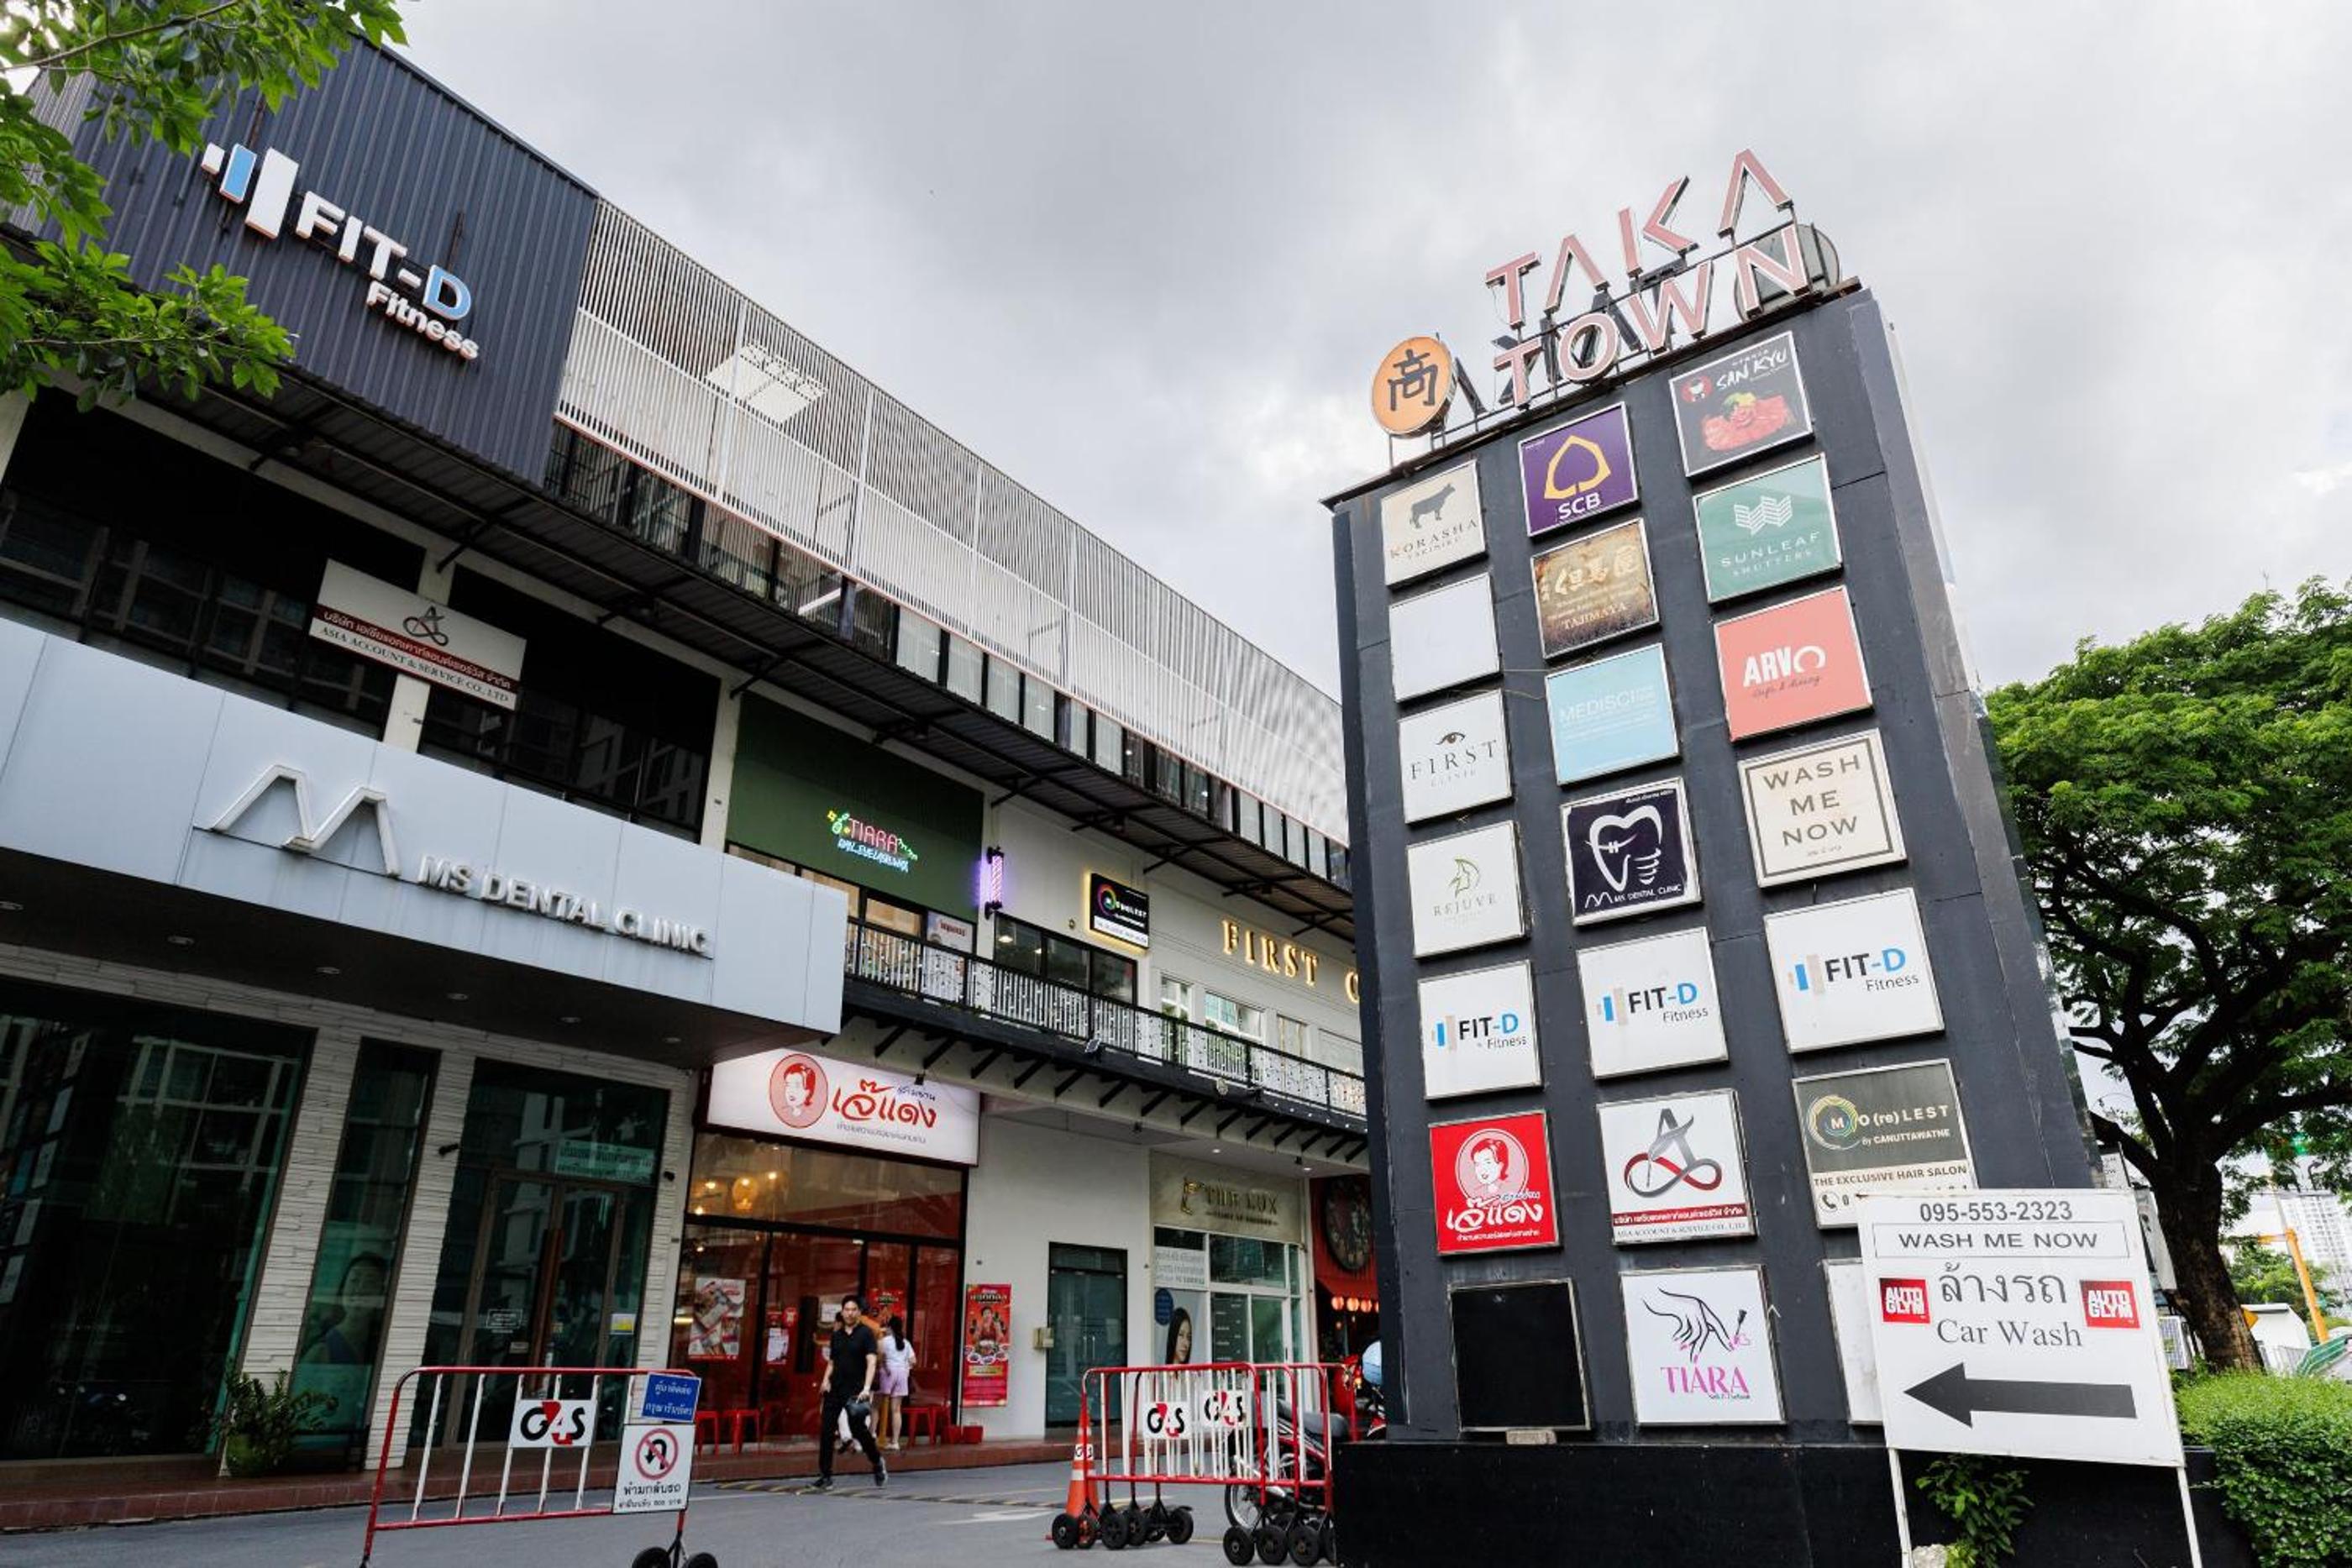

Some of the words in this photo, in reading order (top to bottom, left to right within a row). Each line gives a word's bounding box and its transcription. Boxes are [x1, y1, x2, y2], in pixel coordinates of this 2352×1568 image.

[296, 191, 472, 321] FIT-D
[1486, 149, 1794, 330] TAKA
[366, 281, 480, 360] Fitness
[1494, 223, 1811, 409] TOWN
[1716, 364, 1749, 390] SAN
[1753, 348, 1788, 374] KYU
[1558, 492, 1602, 520] SCB
[1721, 530, 1820, 568] SUNLEAF
[323, 627, 347, 641] ASIA
[350, 638, 404, 663] ACCOUNT
[1743, 645, 1826, 687] ARVO
[1411, 739, 1497, 779] FIRST
[1764, 755, 1860, 790] WASH
[1789, 789, 1840, 815] ME
[848, 818, 898, 855] TIARA
[1782, 816, 1857, 847] NOW
[418, 855, 472, 892] MS
[480, 872, 606, 930] DENTAL
[613, 905, 708, 955] CLINIC
[1222, 919, 1320, 988] FIRST
[1825, 947, 1906, 983] FIT-D
[1628, 983, 1698, 1014] FIT-D
[1866, 974, 1919, 992] Fitness
[1459, 1013, 1519, 1041] FIT-D
[1663, 1008, 1709, 1023] Fitness
[1488, 1036, 1527, 1050] Fitness
[1814, 1177, 1835, 1187] THE
[1837, 1172, 1895, 1185] EXCLUSIVE
[1897, 1168, 1925, 1179] HAIR
[1927, 1164, 1967, 1177] SALON
[1919, 1200, 2073, 1223] 095-553-2323
[1898, 1233, 1973, 1249] WASH
[1984, 1233, 2024, 1249] ME
[2034, 1232, 2098, 1249] NOW
[1886, 1287, 1923, 1301] AUTO
[1938, 1261, 2067, 1304] ล้างรถ
[2088, 1290, 2130, 1305] AUTO
[1887, 1299, 1925, 1314] GLYM
[2089, 1302, 2134, 1318] GLYM
[1936, 1319, 1989, 1344] Car
[1997, 1319, 2083, 1347] Wash
[1661, 1366, 1750, 1394] TIARA
[520, 1401, 585, 1445] G4S
[1147, 1403, 1185, 1438] G4S
